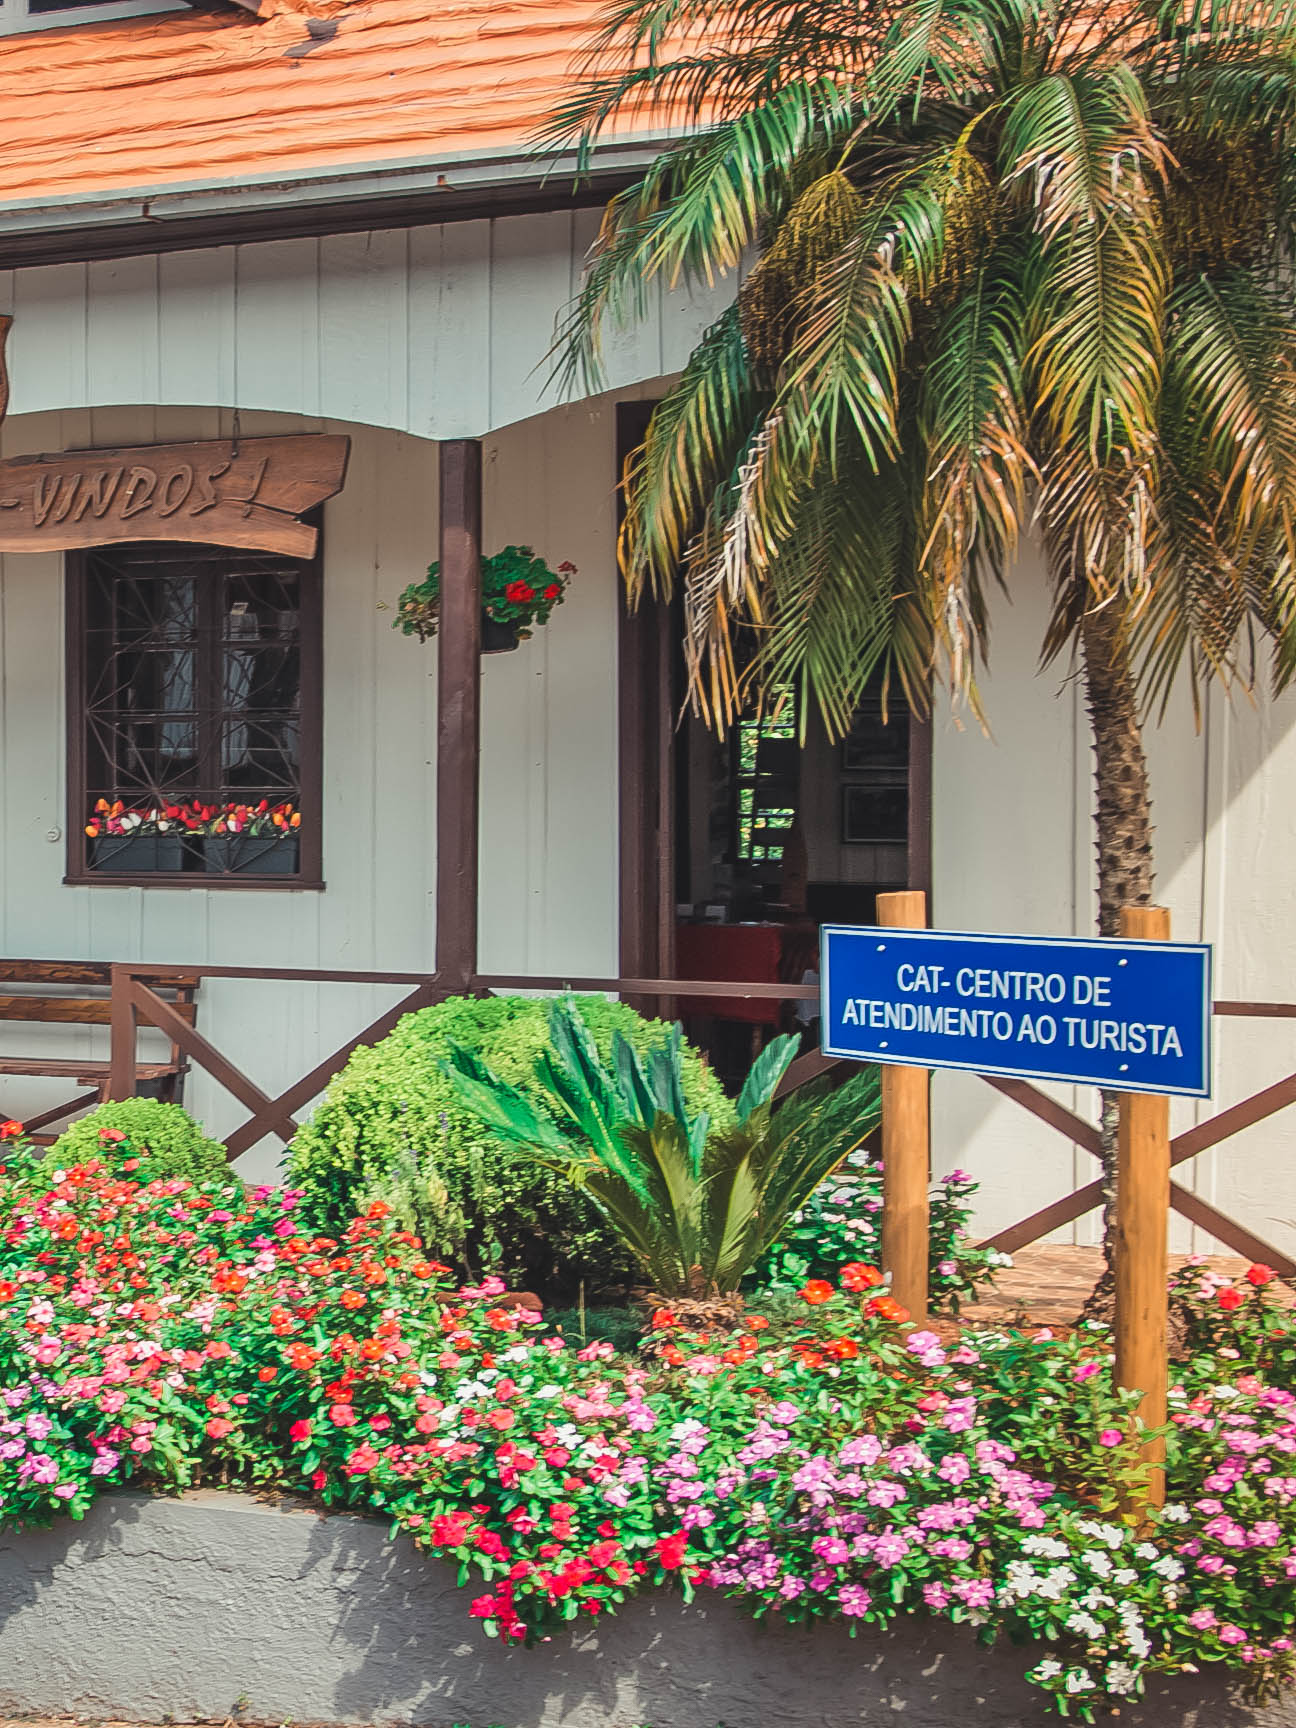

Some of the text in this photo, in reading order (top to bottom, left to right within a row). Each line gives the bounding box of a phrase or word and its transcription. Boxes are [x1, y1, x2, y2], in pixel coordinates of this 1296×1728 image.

[956, 967, 1066, 1004] CENTRO
[1073, 975, 1112, 1007] DE
[841, 998, 1184, 1058] ATENDIMENTO AO TURISTA
